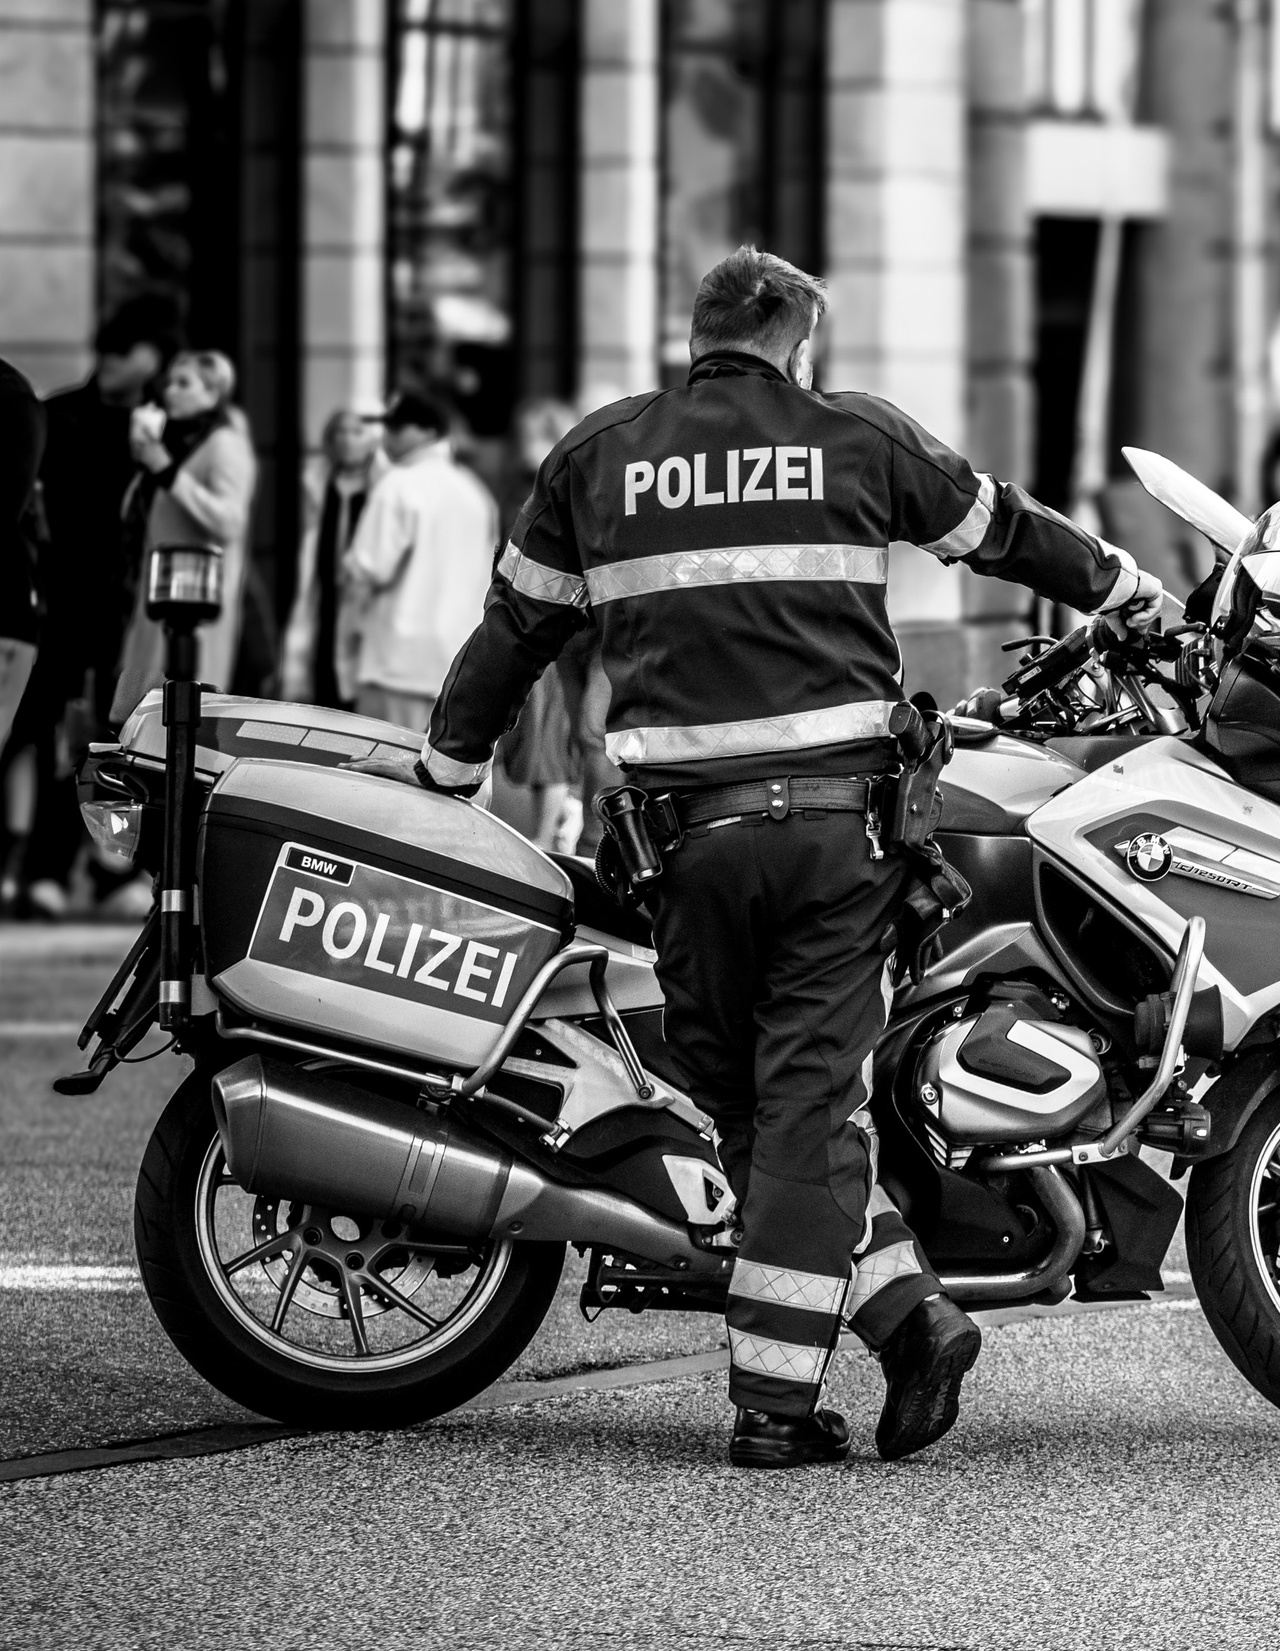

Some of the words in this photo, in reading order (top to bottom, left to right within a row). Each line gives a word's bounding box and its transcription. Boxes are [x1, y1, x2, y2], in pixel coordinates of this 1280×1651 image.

[624, 446, 824, 516] POLIZEI
[301, 856, 338, 875] BMW
[1136, 834, 1171, 855] BMW
[278, 886, 519, 1008] POLIZEI
